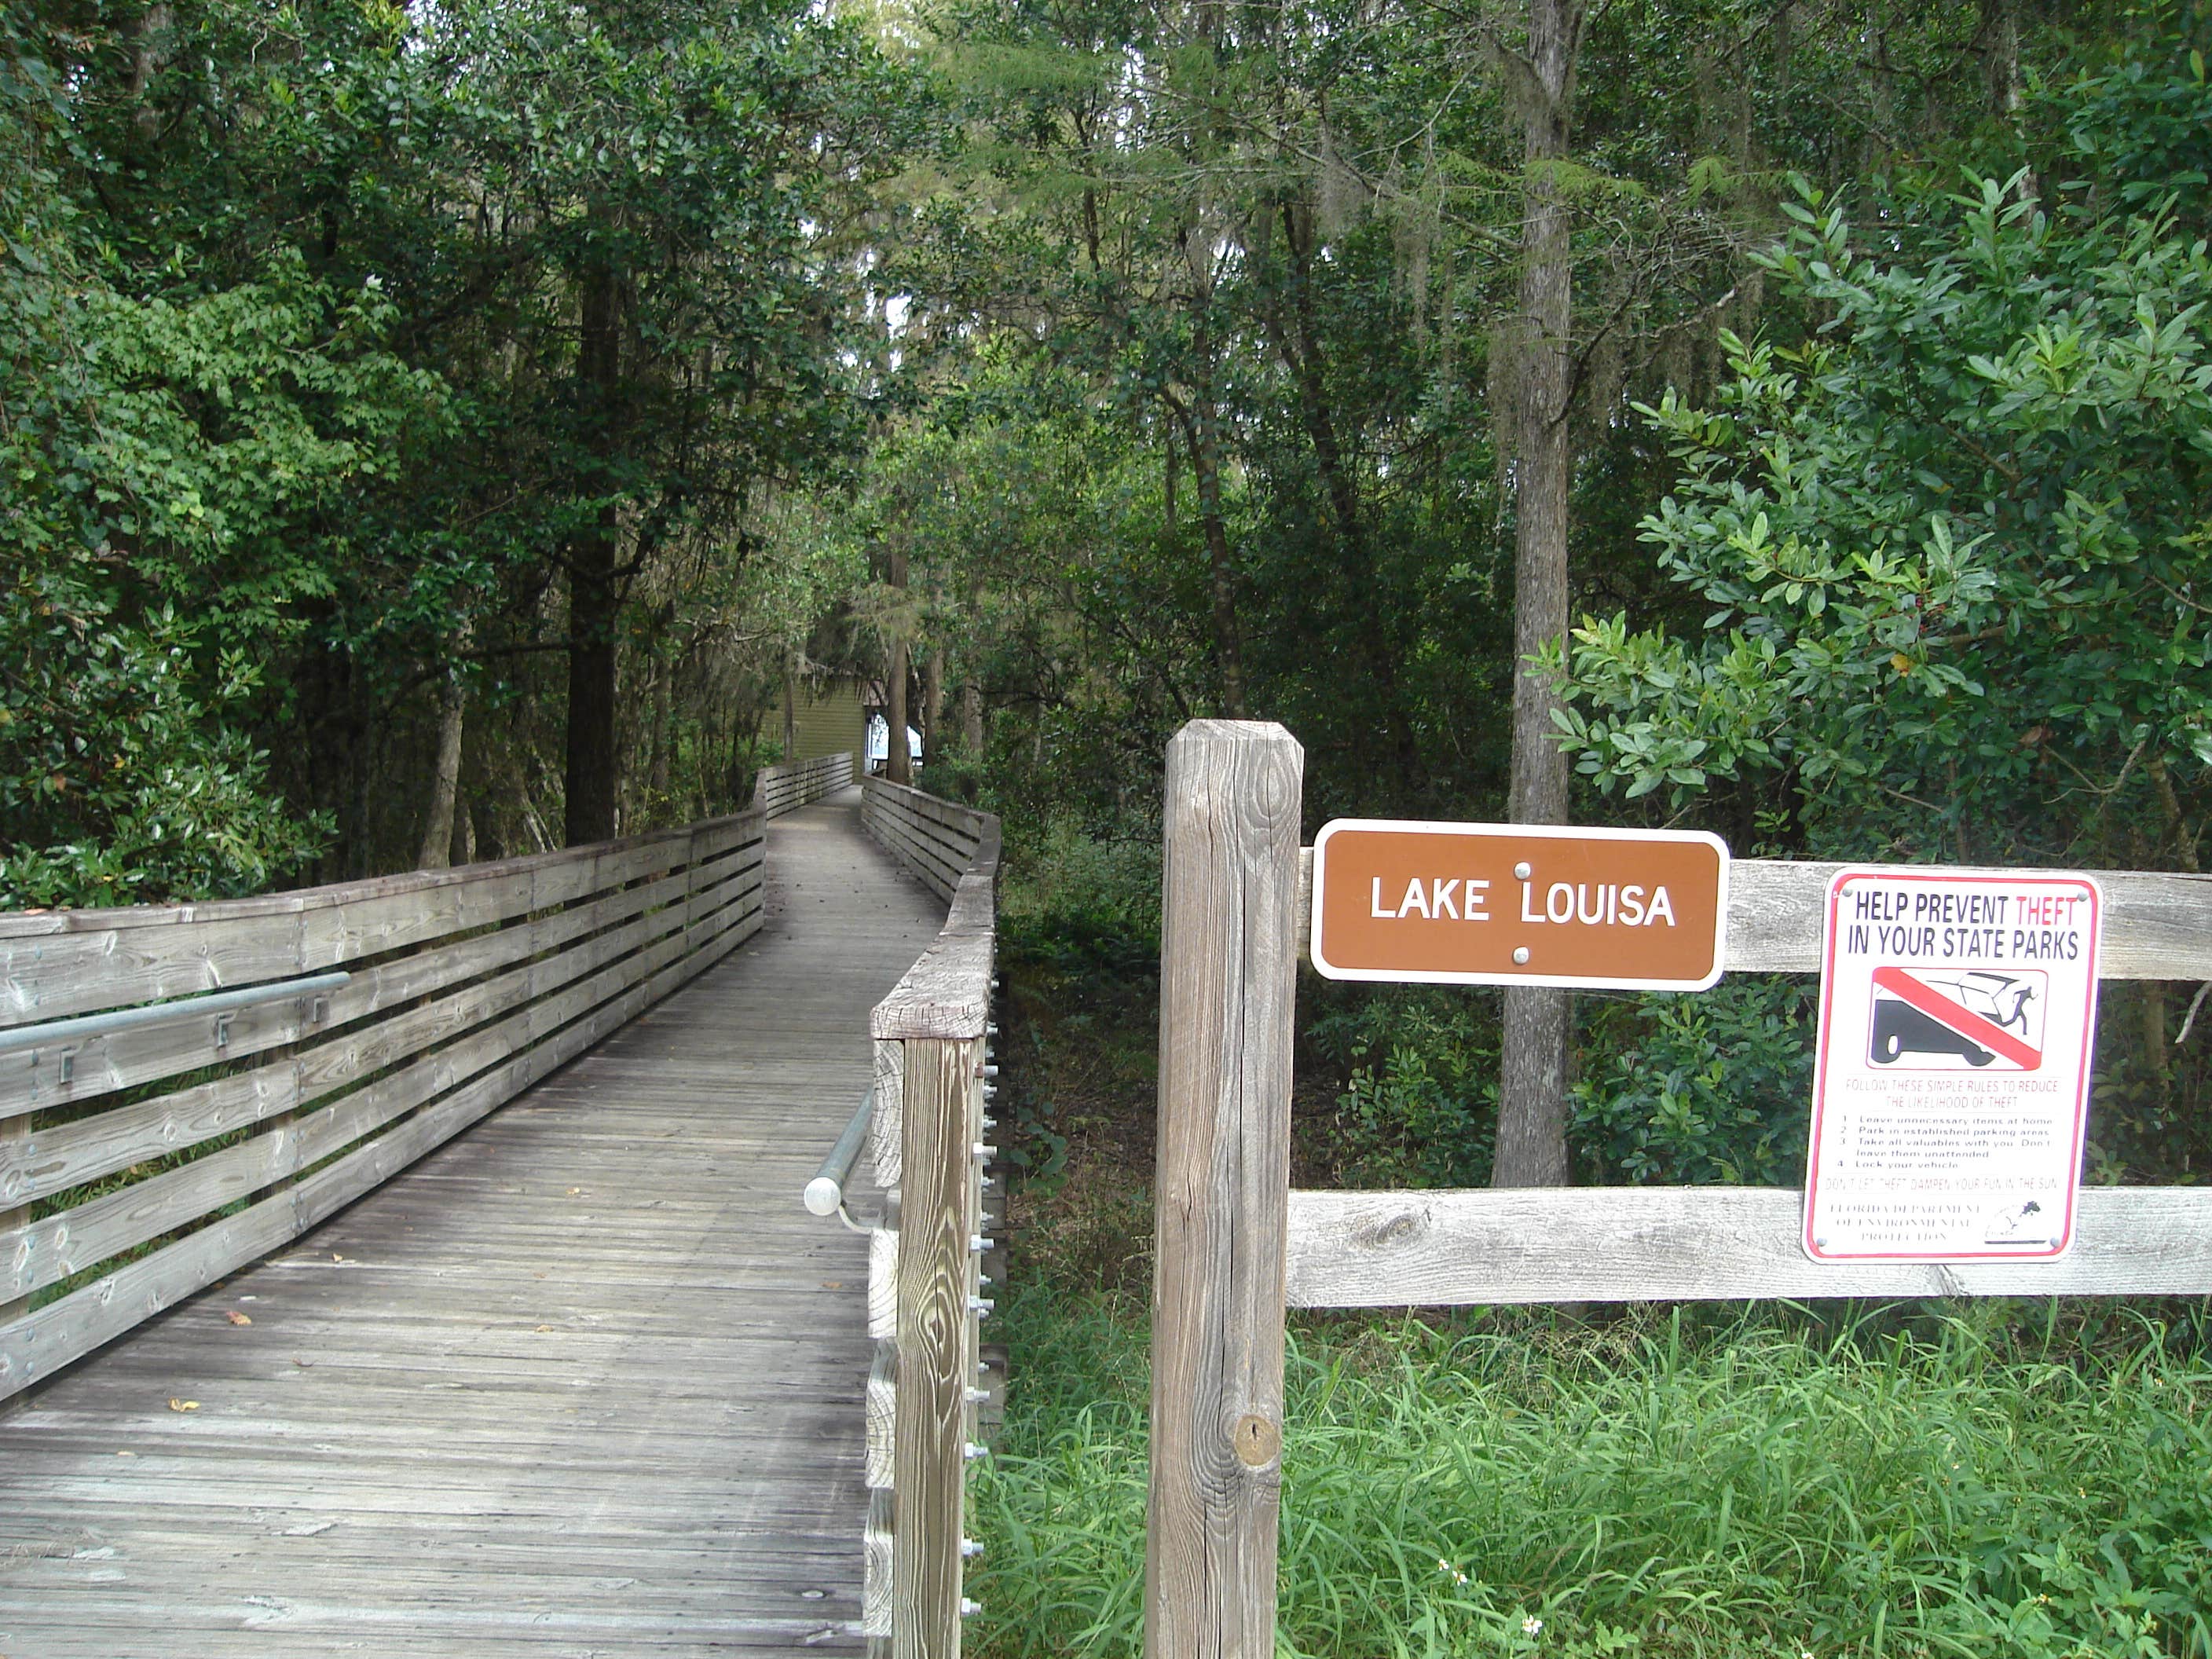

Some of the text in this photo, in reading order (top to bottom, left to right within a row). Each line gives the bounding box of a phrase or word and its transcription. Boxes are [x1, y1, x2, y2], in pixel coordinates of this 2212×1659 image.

[1371, 876, 1675, 927] LAKE LOUISA
[1856, 891, 2078, 925] HELP PREVENT THEFT
[1848, 925, 2078, 960] IN YOUR STATE PARKS
[1845, 1079, 2059, 1093] FOLLOW THESE SIMPLE RULES TO REDUCE
[1885, 1096, 2018, 1108] THE LIKELIHOOD OF THEFT
[1973, 1129, 2016, 1137] parking
[1825, 1177, 1855, 1189] DONT
[1910, 1177, 1950, 1189] DAMPEN
[1954, 1178, 1979, 1189] YOUR
[2019, 1177, 2034, 1188] THE
